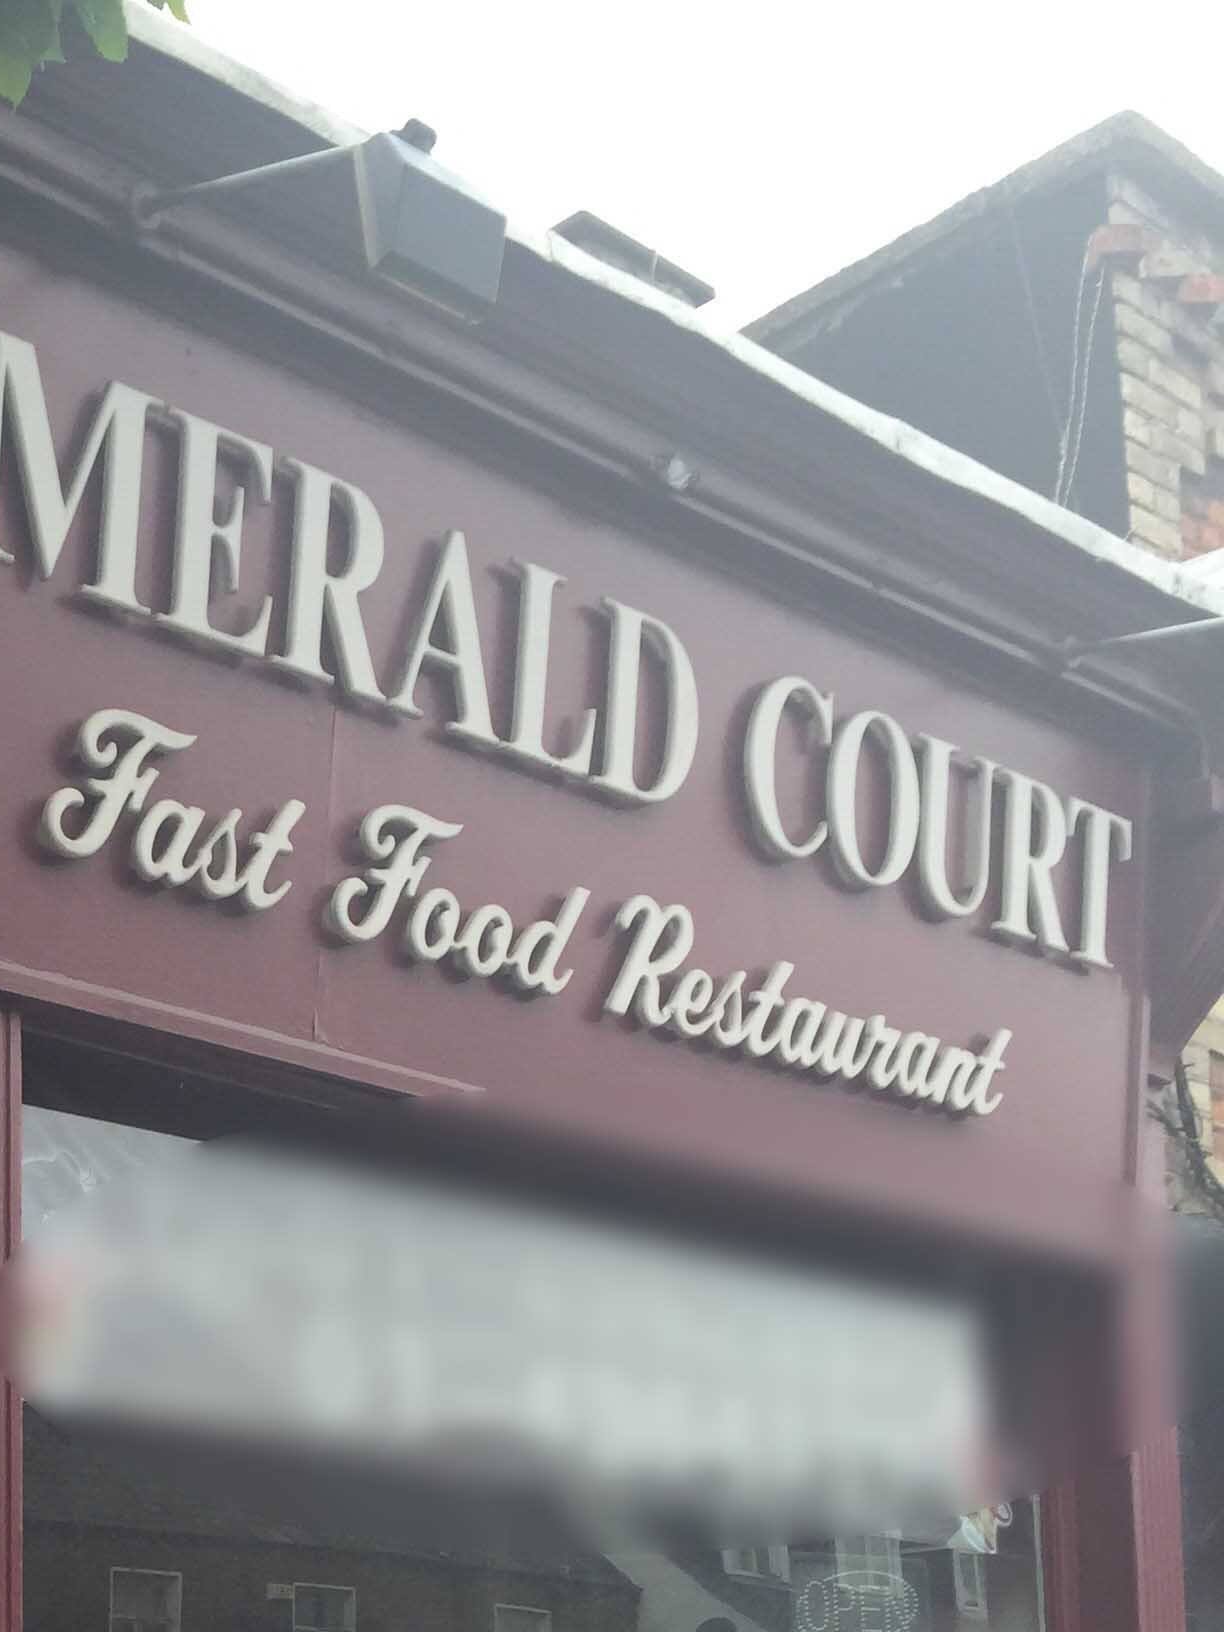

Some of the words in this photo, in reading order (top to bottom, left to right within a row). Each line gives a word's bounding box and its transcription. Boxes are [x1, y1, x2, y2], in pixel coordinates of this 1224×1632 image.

[40, 708, 306, 912] Fast
[328, 804, 591, 995] Food
[604, 895, 1014, 1117] Restaurant
[744, 675, 1132, 969] COURT
